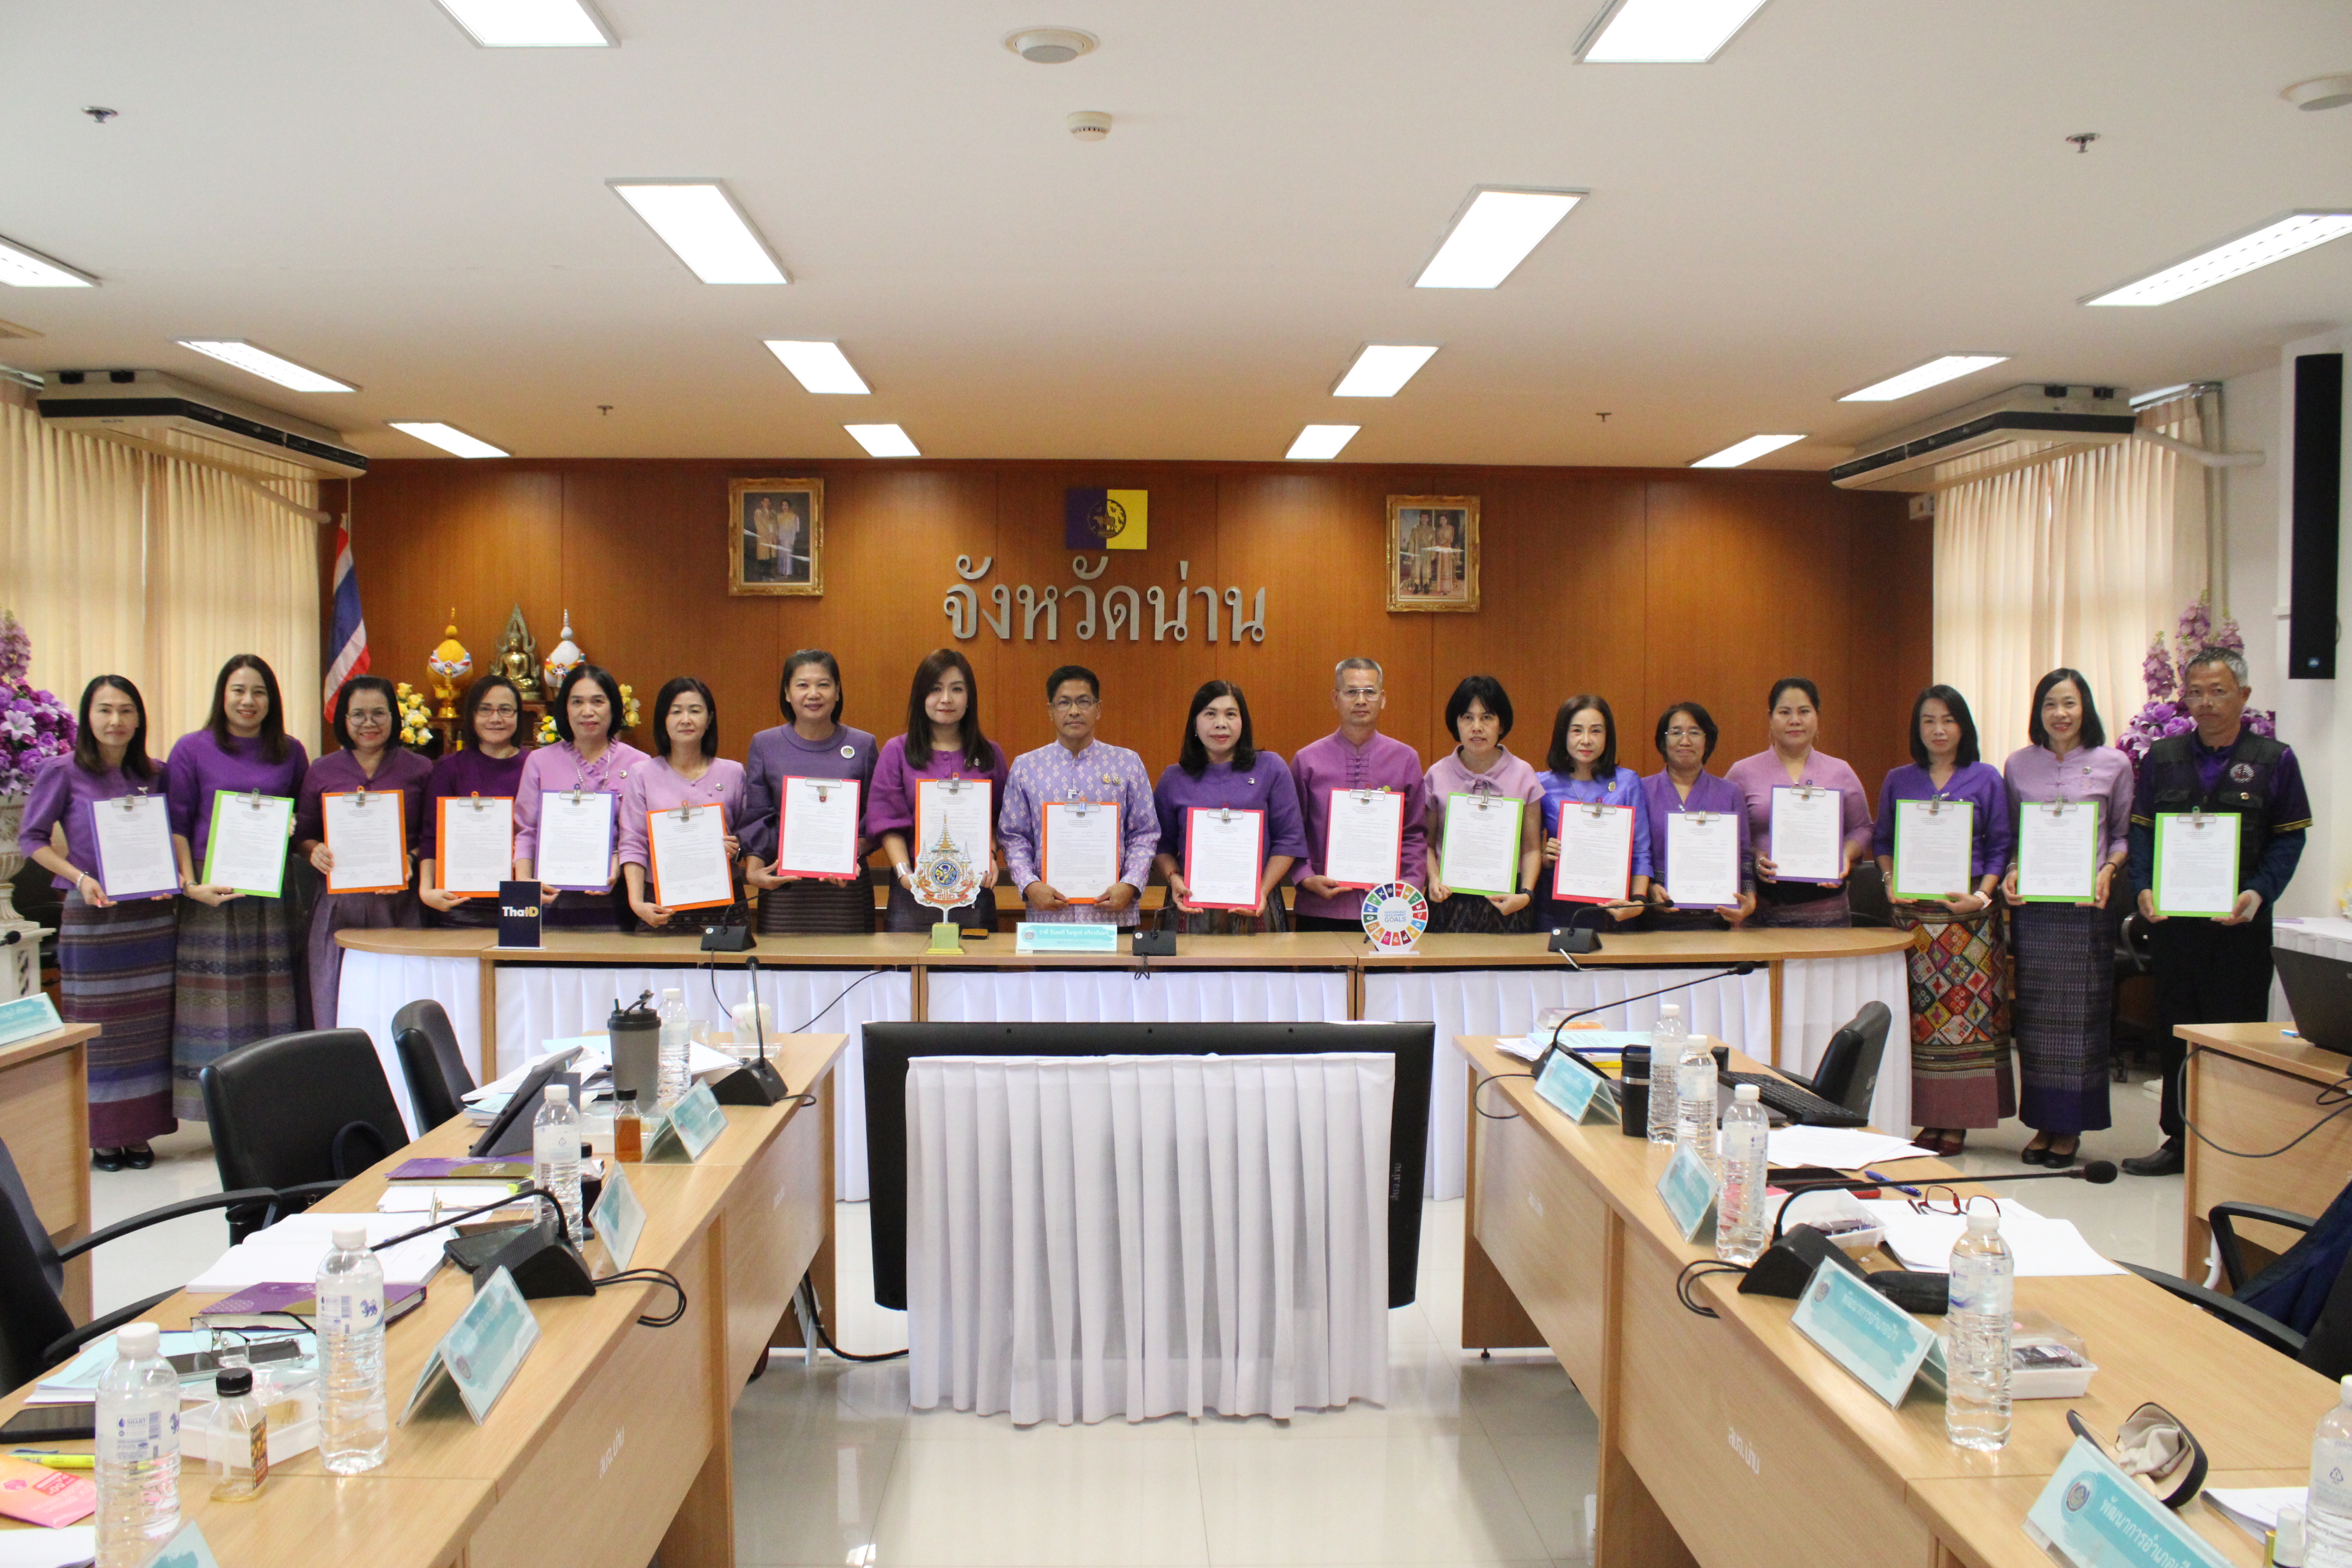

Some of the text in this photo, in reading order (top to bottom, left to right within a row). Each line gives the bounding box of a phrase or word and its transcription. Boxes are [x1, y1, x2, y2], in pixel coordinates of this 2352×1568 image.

[944, 554, 1266, 642] จังหวัดน่าน
[502, 906, 539, 917] ThaiD
